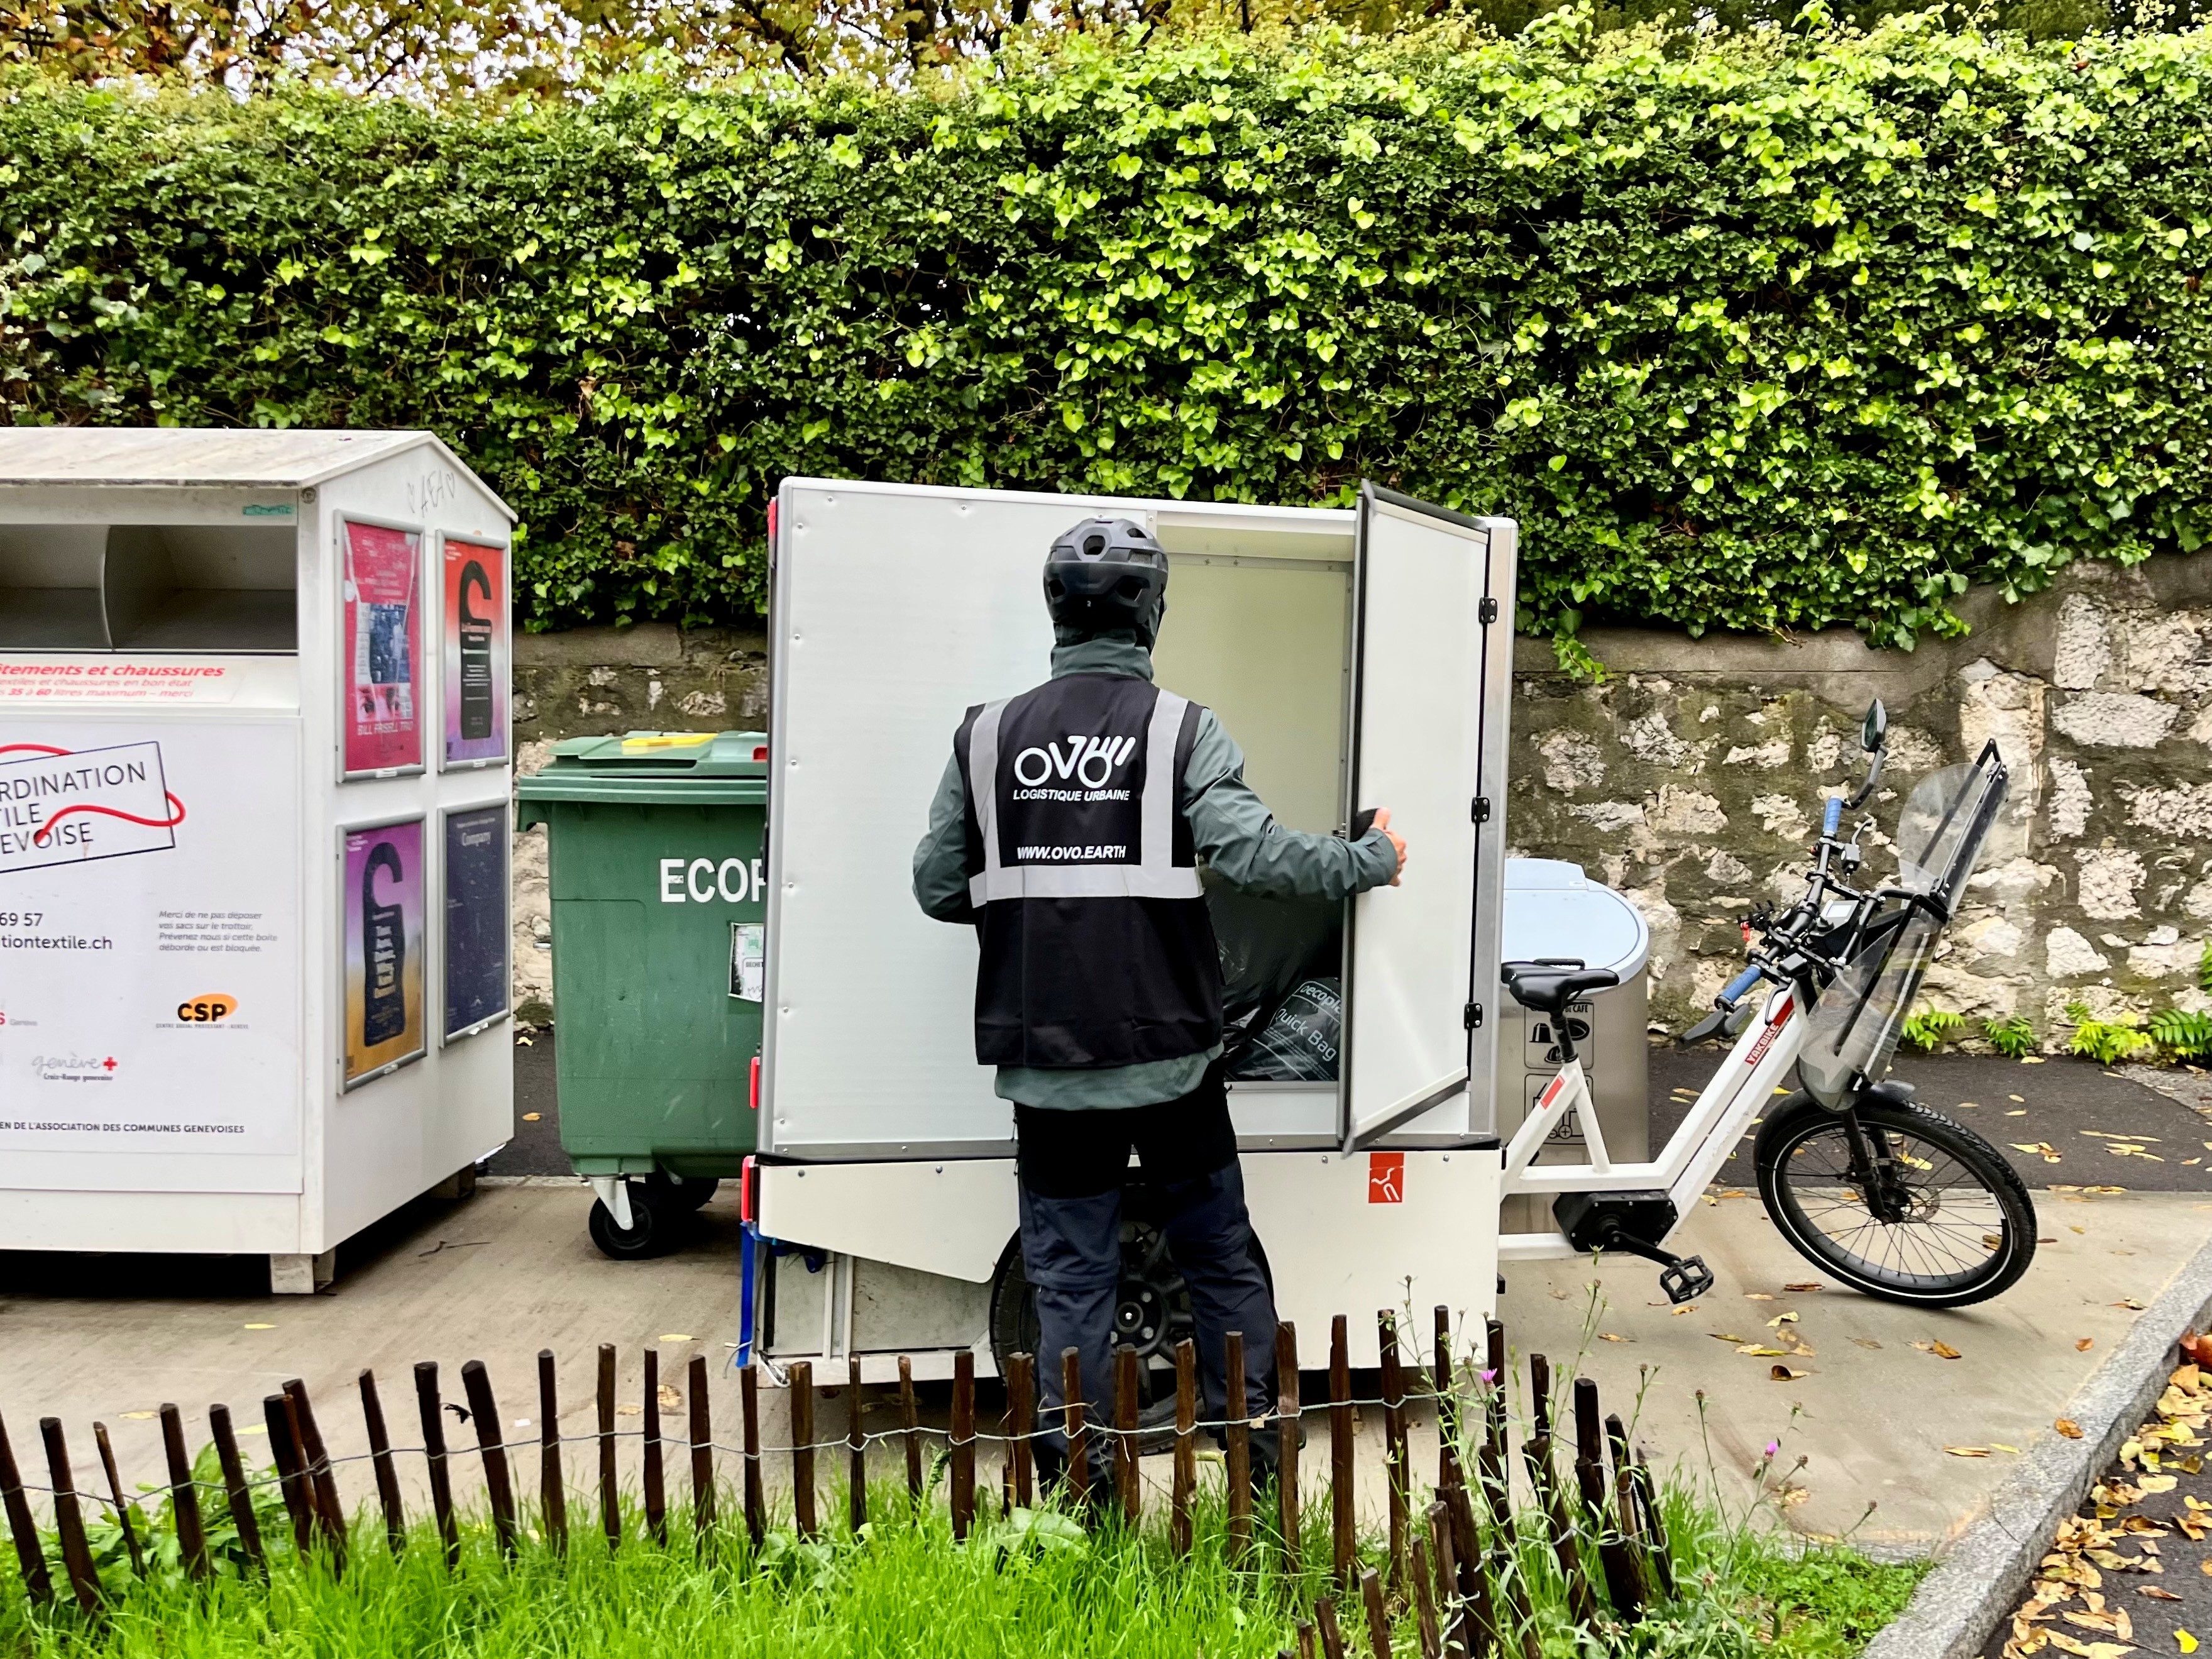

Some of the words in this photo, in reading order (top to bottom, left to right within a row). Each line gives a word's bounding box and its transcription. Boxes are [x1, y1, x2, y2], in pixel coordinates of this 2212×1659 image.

[88, 666, 109, 675] et
[113, 664, 225, 676] chaussures
[0, 761, 146, 803] RDINATION
[1013, 788, 1082, 802] LOGISTIQUE
[1084, 789, 1130, 802] URBAINE
[0, 803, 43, 827] ILE
[0, 822, 94, 854] EVOISE
[1016, 845, 1126, 860] WWW.OVO.EARTH
[0, 912, 18, 926] 69
[24, 913, 43, 926] 57
[228, 912, 262, 920] déposer
[1, 934, 113, 949] tiontextile.ch
[177, 1003, 227, 1022] CSP
[1307, 1029, 1337, 1062] Bag
[1747, 1023, 1780, 1063] YAKBIKE
[28, 1122, 100, 1131] L'ASSOCIATION
[103, 1123, 121, 1132] DES
[123, 1123, 181, 1132] COMMUNES
[184, 1125, 245, 1133] GENEVOISES
